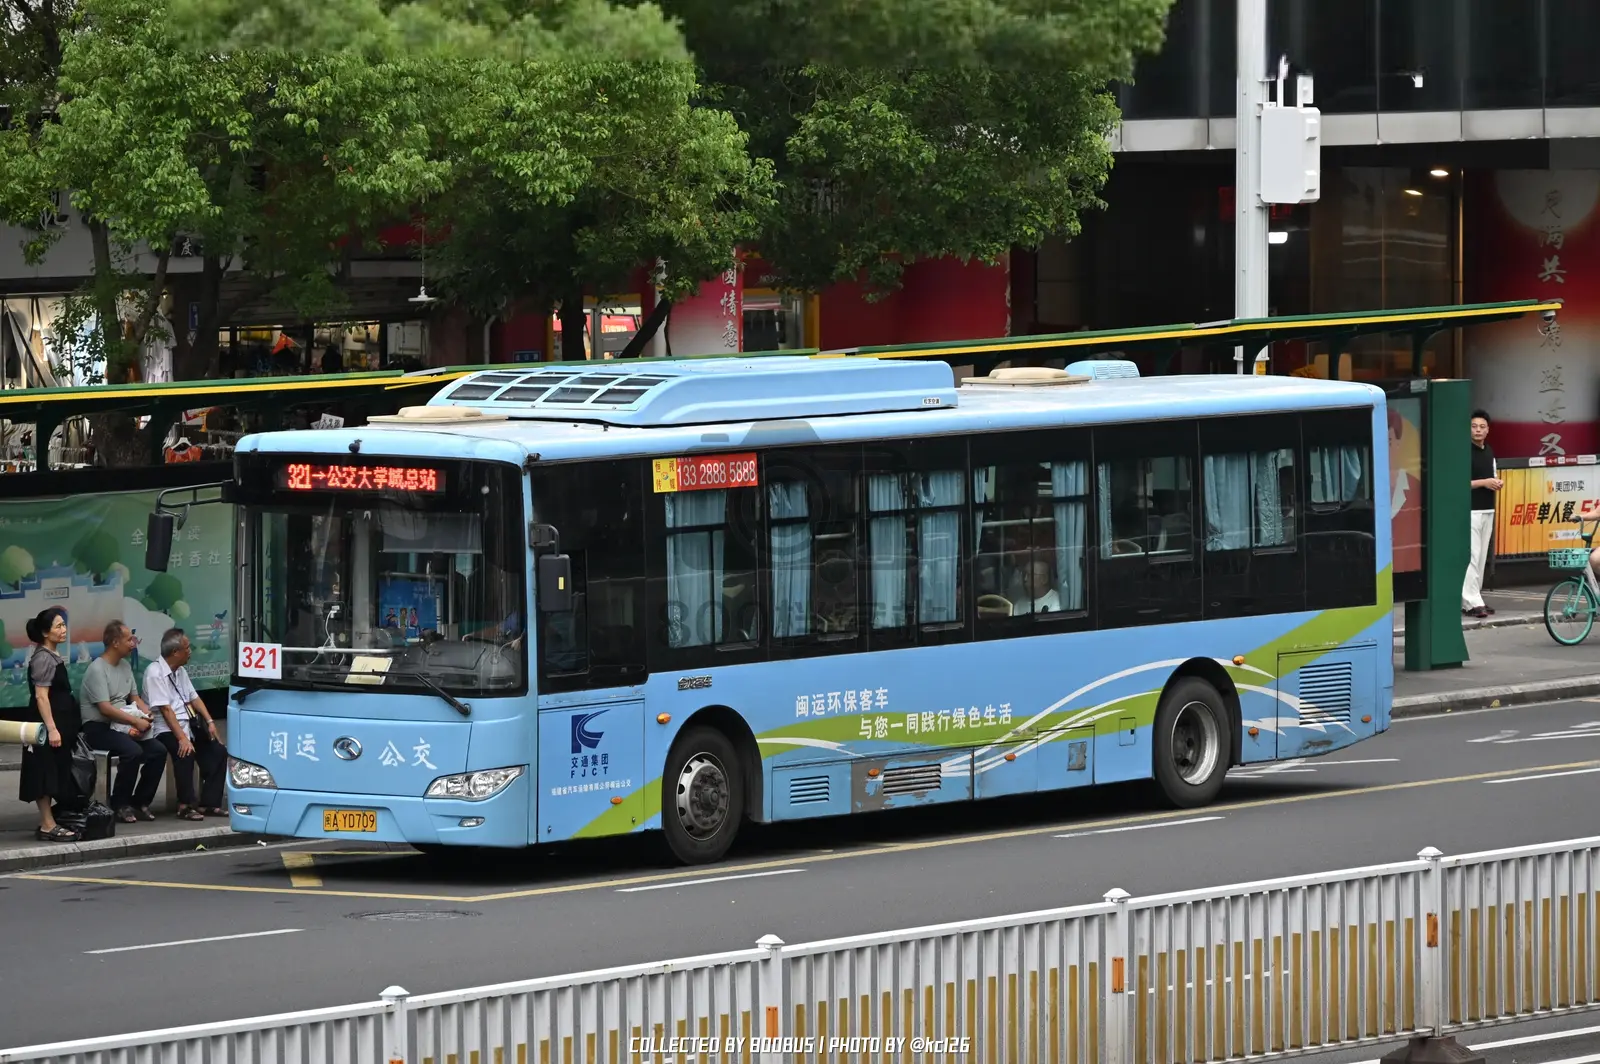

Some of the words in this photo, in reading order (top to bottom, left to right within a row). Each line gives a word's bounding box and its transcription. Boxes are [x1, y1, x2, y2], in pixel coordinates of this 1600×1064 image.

[287, 464, 312, 489] 321
[327, 465, 436, 491] 公交大学城总站
[677, 464, 697, 486] 133
[700, 462, 727, 485] 2888
[729, 460, 756, 482] 5888
[1555, 480, 1585, 492] 美团外卖
[170, 550, 232, 568] 书香社
[242, 646, 277, 669] 321
[795, 687, 890, 718] 闽运环保客车
[858, 703, 1013, 740] 与您一同践行绿色生活
[268, 730, 320, 761] 闽运
[378, 737, 438, 770] 公交
[571, 753, 608, 768] 交通集团
